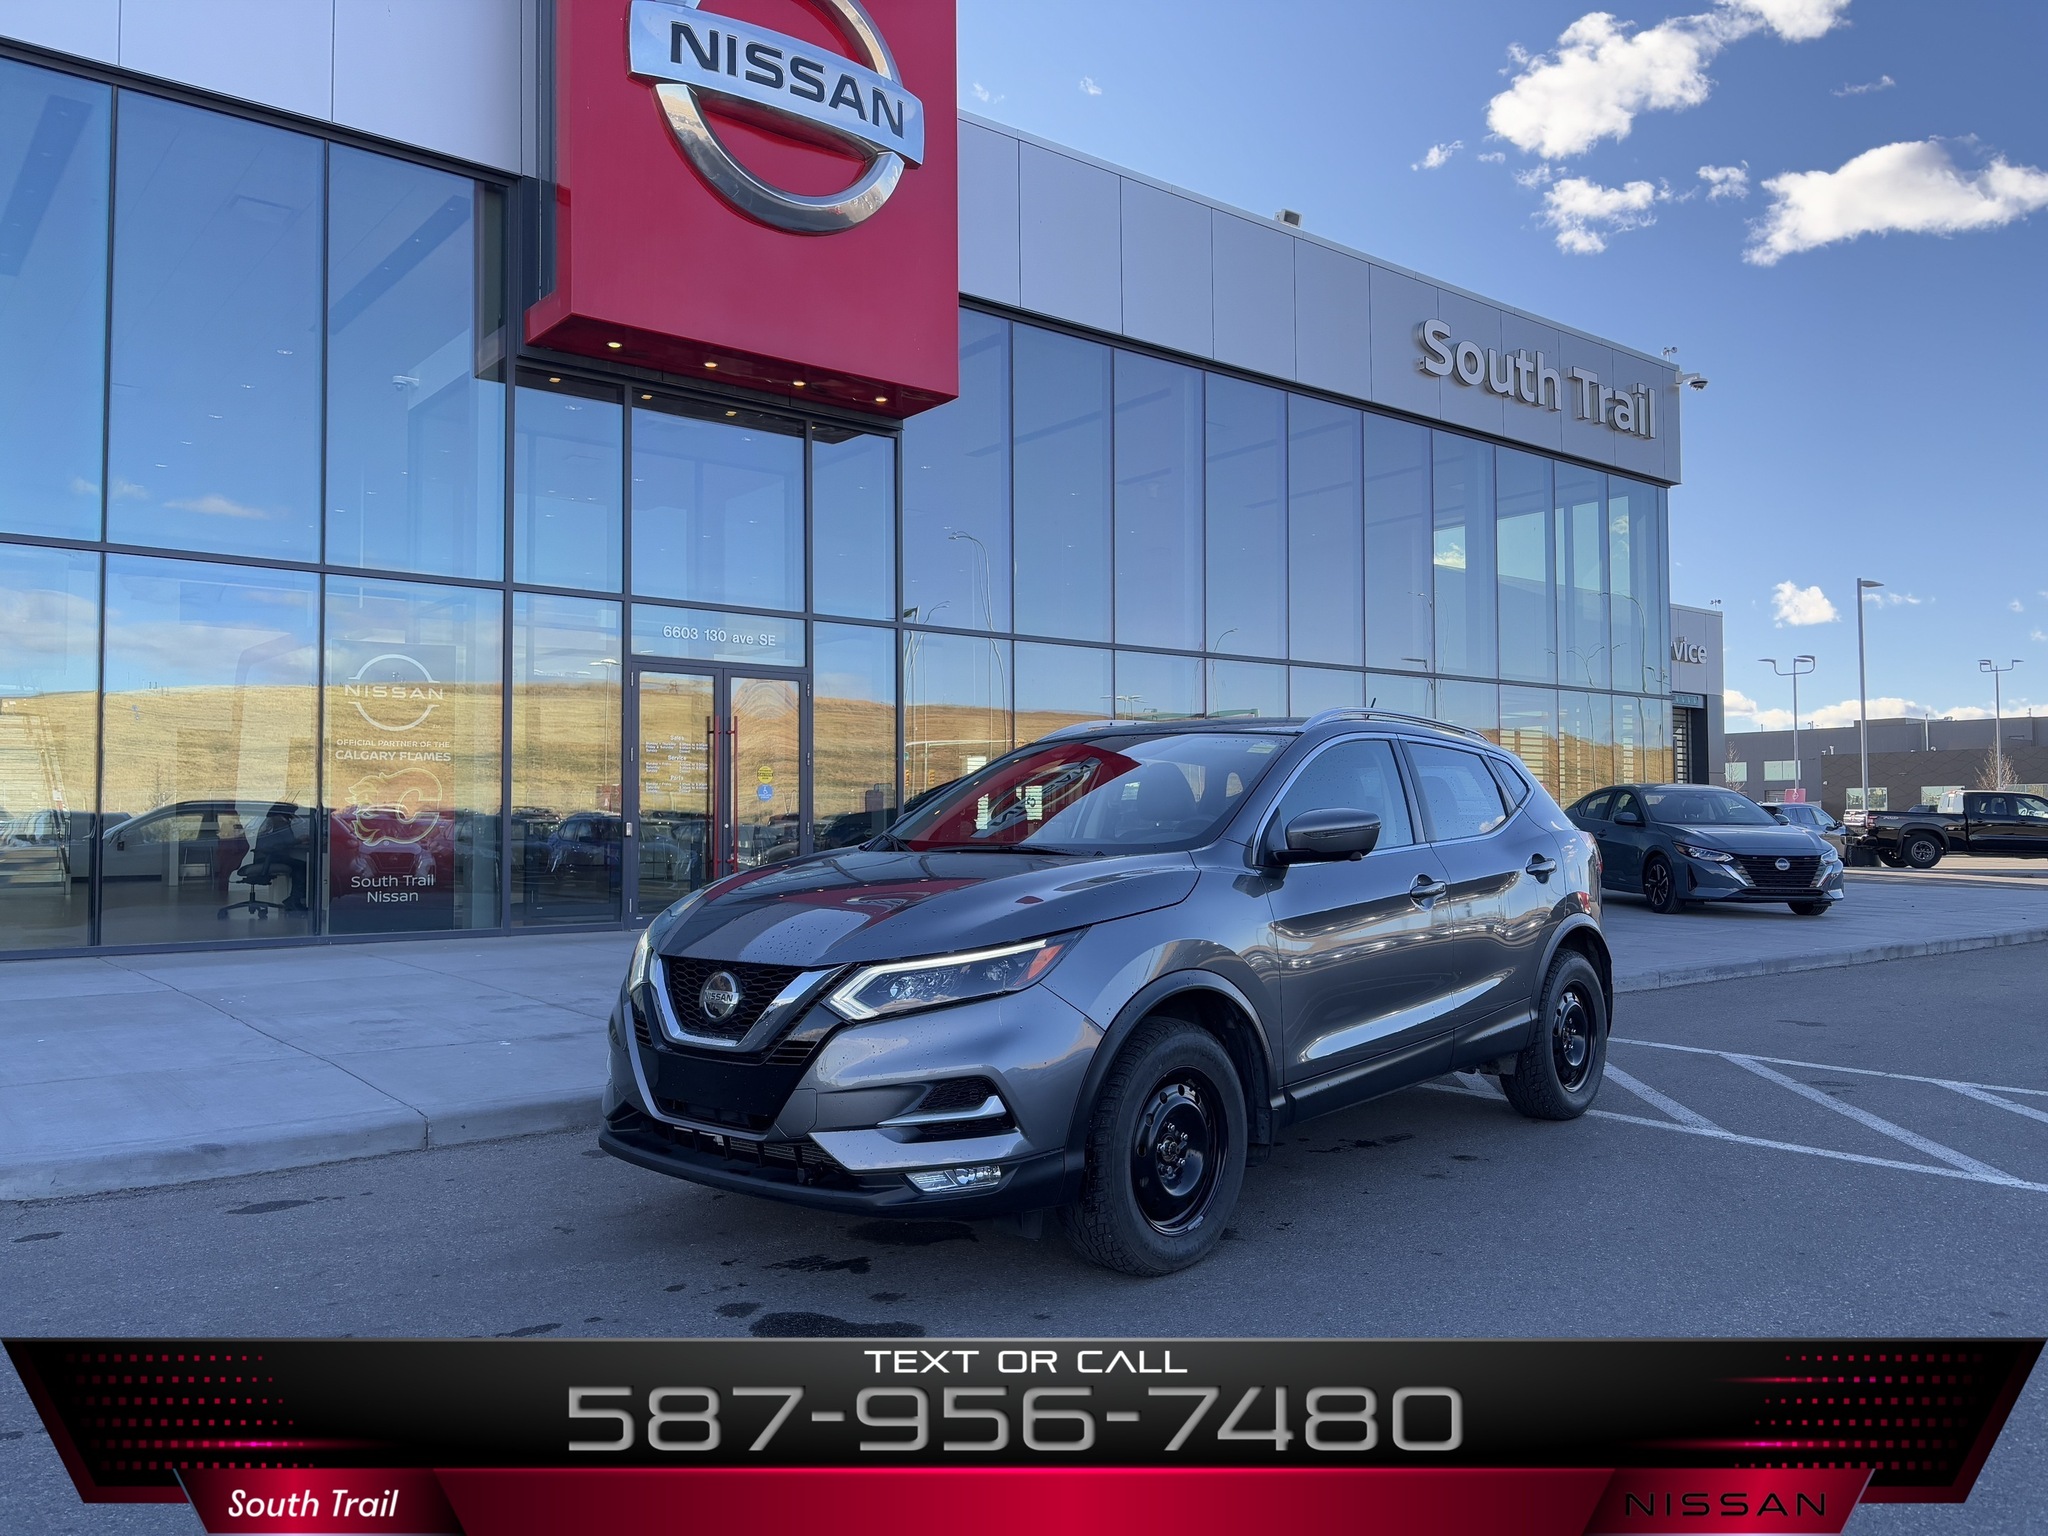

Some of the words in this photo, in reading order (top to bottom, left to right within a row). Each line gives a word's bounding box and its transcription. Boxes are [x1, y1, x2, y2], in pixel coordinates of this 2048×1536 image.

[670, 20, 904, 139] NISSAN
[1418, 318, 1562, 411] South
[1567, 365, 1657, 439] Trail
[663, 625, 699, 640] 6603
[704, 629, 727, 643] 130
[732, 634, 754, 645] ave
[759, 633, 777, 647] SE
[1671, 636, 1707, 664] vice
[344, 684, 444, 700] NISSAN
[336, 738, 376, 747] OFFICIAL
[378, 740, 418, 748] PARTNER
[420, 740, 432, 748] OF
[335, 750, 397, 761] CALGARY
[400, 751, 452, 762] FLAMES
[350, 874, 399, 888] South
[402, 874, 434, 887] Trail
[367, 890, 419, 903] Nissan
[705, 991, 733, 1002] NISSAN
